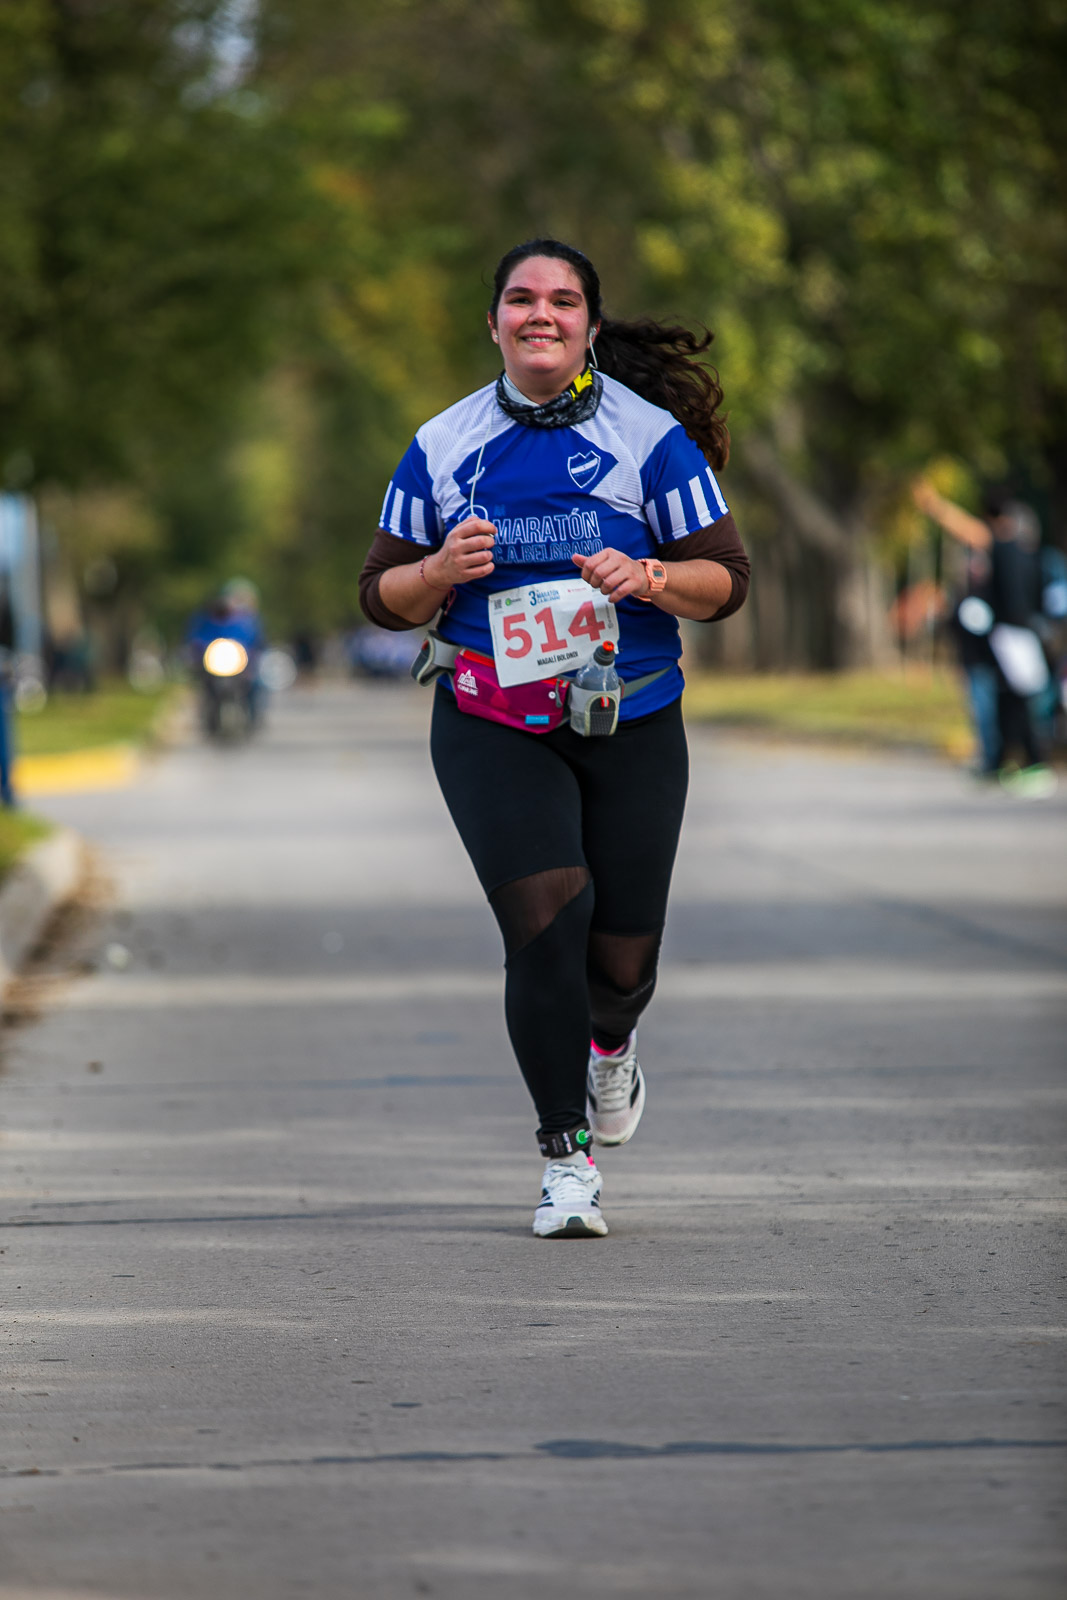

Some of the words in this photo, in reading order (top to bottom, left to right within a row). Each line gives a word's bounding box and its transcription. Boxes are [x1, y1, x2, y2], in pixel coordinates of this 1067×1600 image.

[493, 507, 601, 545] MARATÓN
[528, 590, 537, 606] 3
[503, 600, 606, 659] 514
